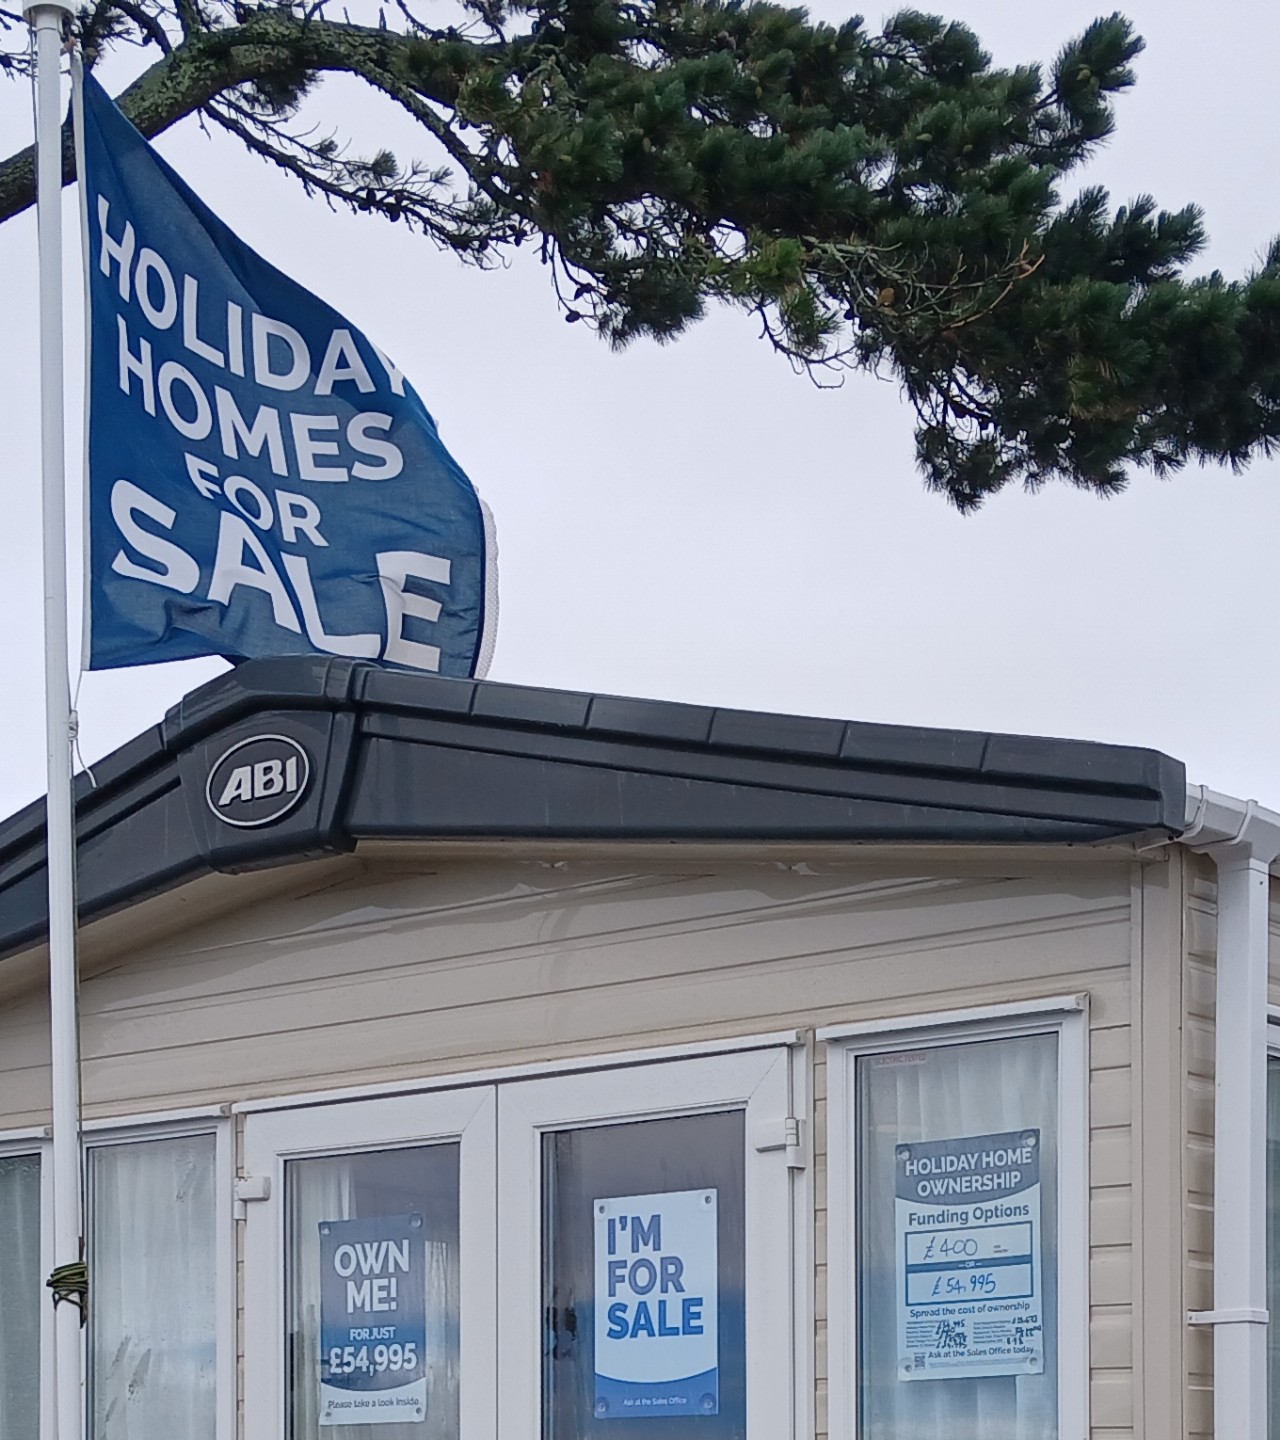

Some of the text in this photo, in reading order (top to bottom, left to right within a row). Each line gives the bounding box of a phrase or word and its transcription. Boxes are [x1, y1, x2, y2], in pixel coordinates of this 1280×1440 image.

[116, 313, 405, 484] HOMES
[184, 451, 330, 548] FOR
[110, 479, 452, 673] SALE
[218, 755, 297, 806] ABI
[905, 1147, 1032, 1177] HOLIDAY HOME
[917, 1170, 1022, 1198] OWNERSHIP
[908, 1204, 1030, 1226] Funding Options
[607, 1214, 661, 1255] I'M
[334, 1239, 410, 1278] OWN
[607, 1256, 686, 1298] FOR
[346, 1276, 398, 1314] ME!
[910, 1301, 1030, 1319] Spread the cost of ownership
[349, 1326, 396, 1341] FOR JUST
[606, 1297, 704, 1340] SALE
[329, 1342, 418, 1377] £54,995
[928, 1345, 1034, 1359] Ask at the Sales Office today
